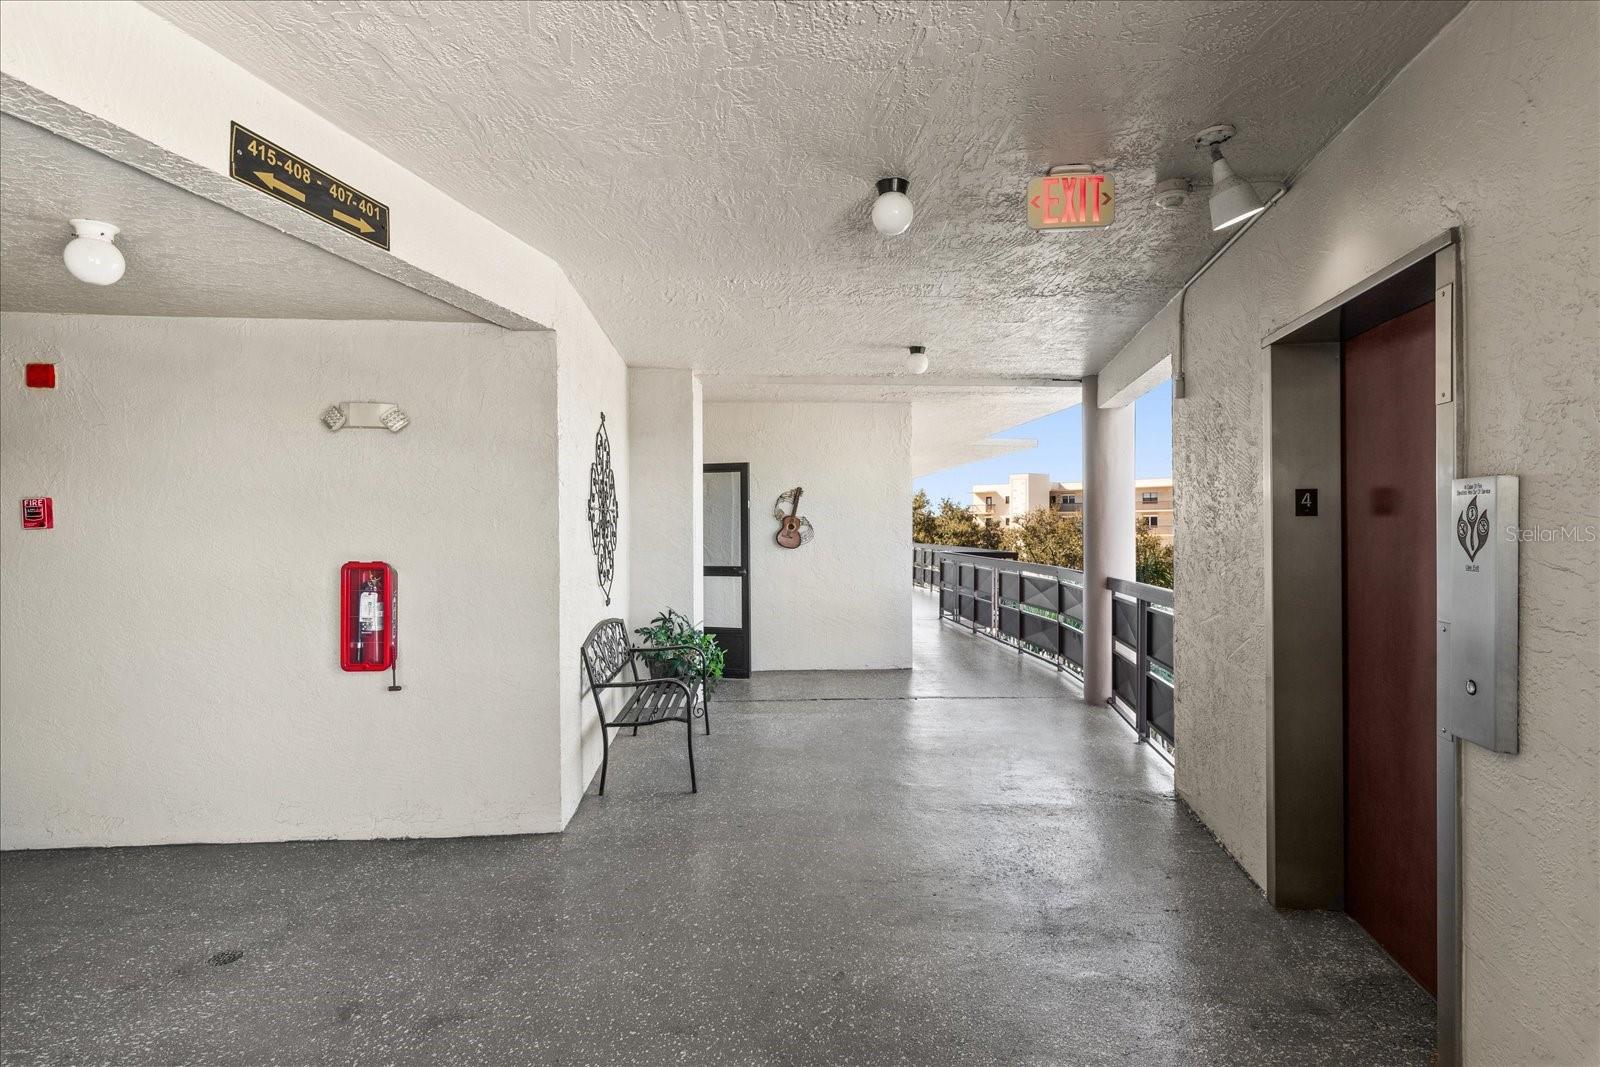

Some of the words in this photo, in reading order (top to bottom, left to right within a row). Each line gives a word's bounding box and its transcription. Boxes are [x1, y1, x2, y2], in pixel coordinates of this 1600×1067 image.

[247, 140, 311, 185] 415-408
[329, 184, 380, 220] 407-401
[1043, 176, 1105, 224] EXIT
[1301, 492, 1313, 507] 4
